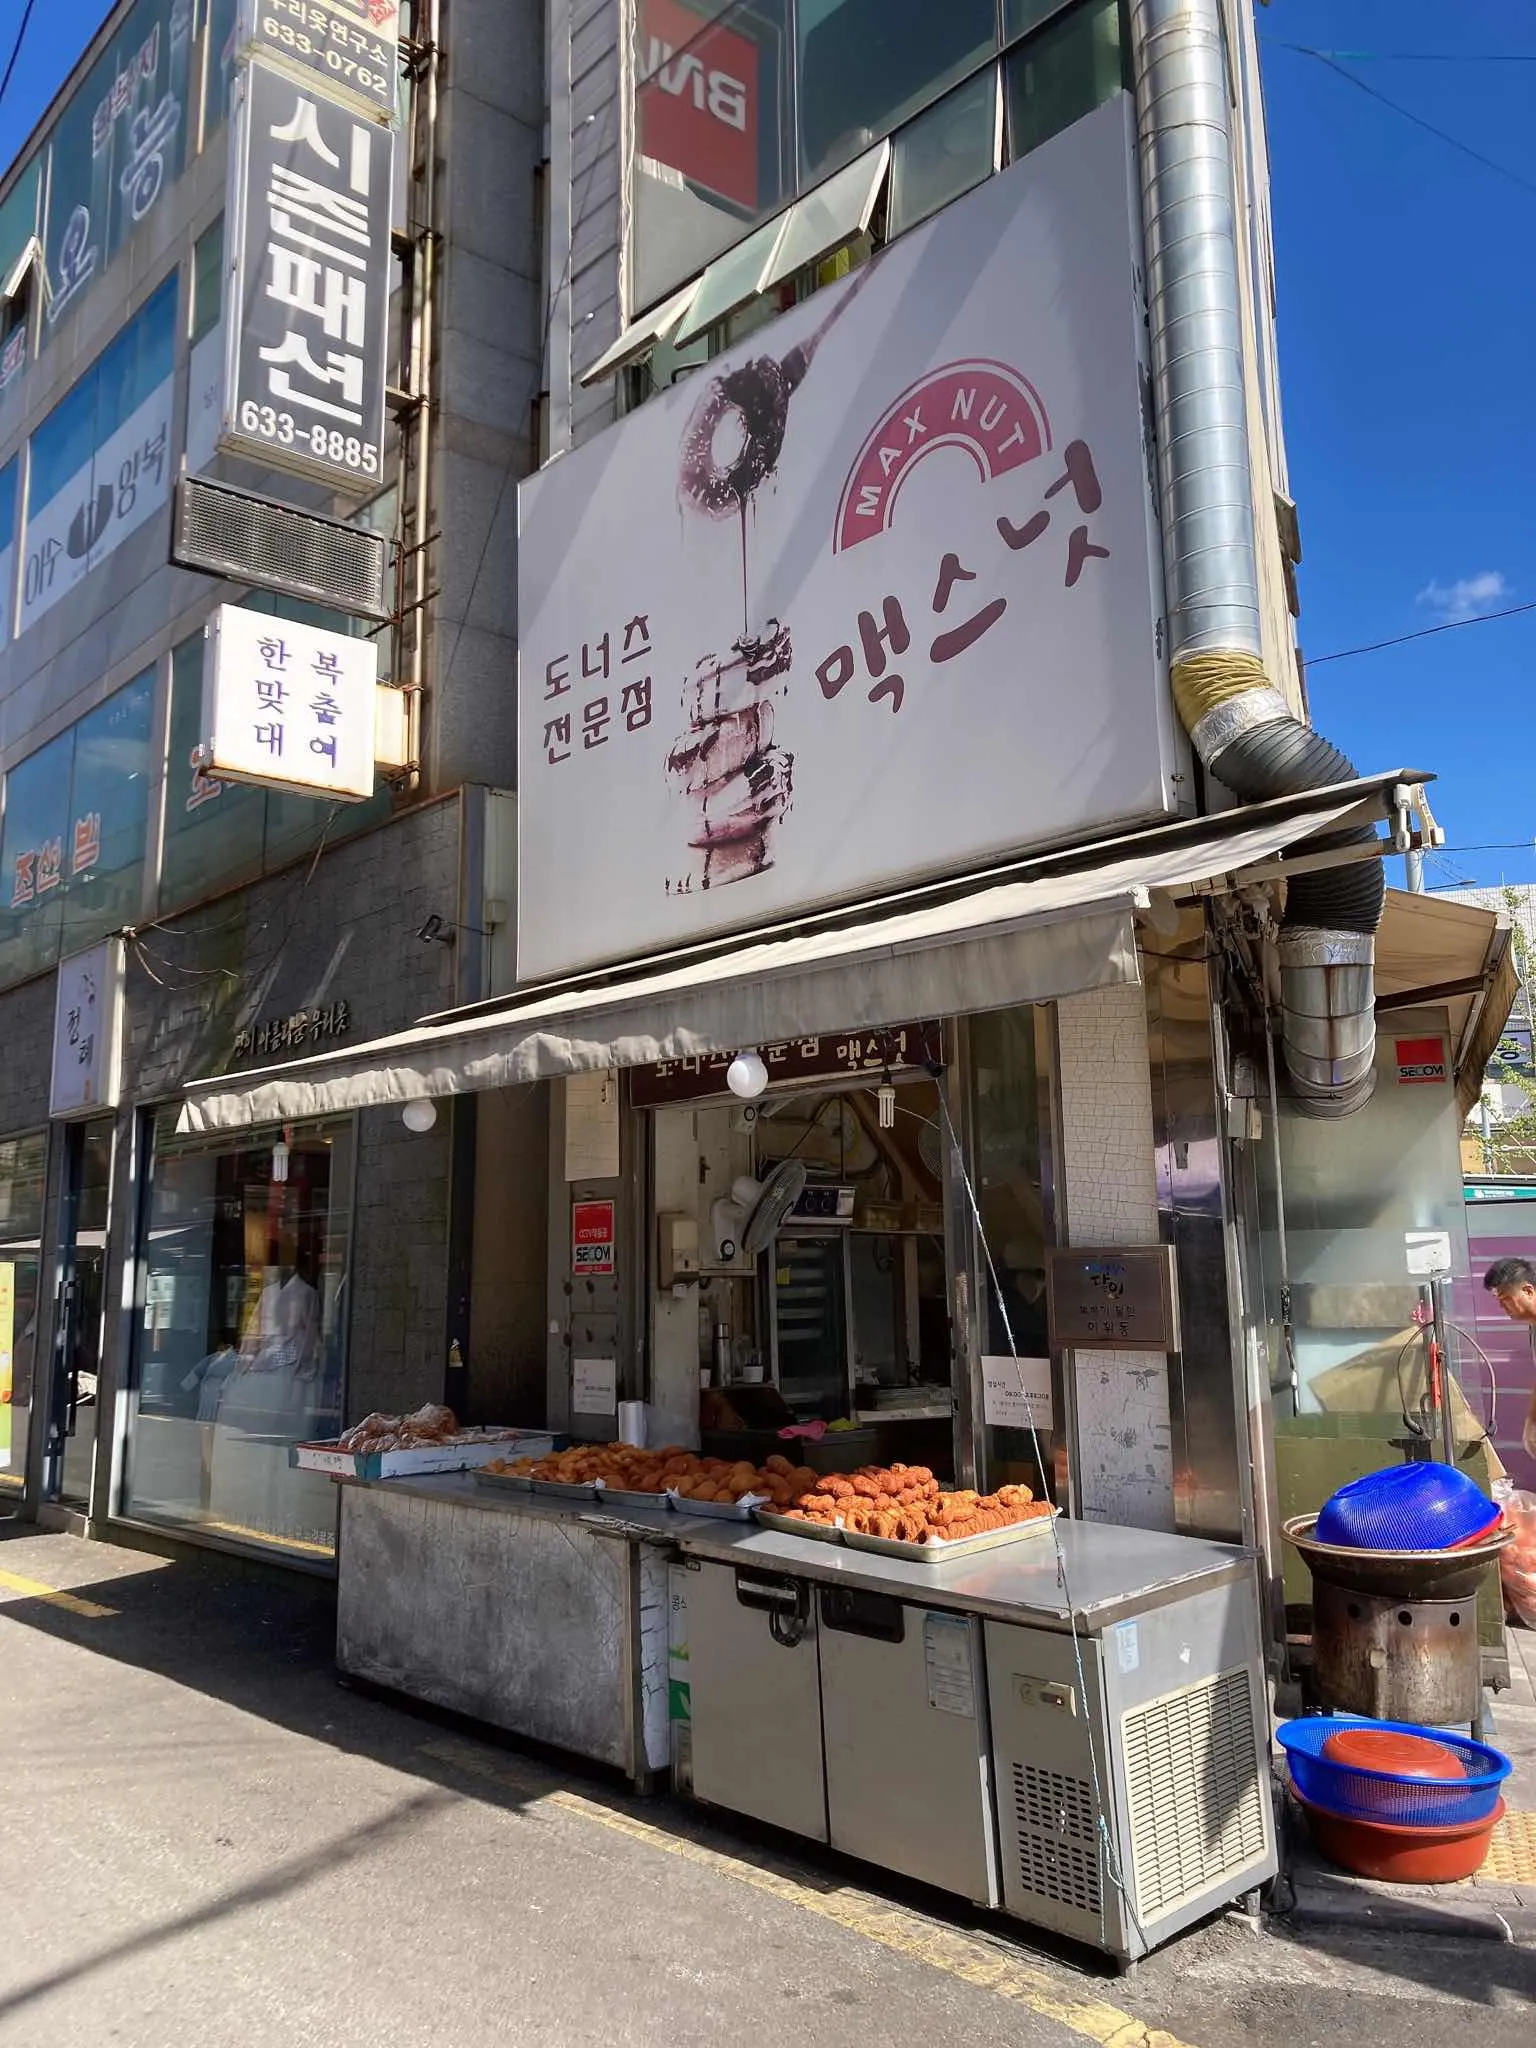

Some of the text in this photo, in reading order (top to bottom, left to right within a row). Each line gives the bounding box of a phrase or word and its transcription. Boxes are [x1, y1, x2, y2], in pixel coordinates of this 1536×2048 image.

[262, 16, 388, 96] 633-0762
[258, 96, 372, 426] 시즌패션
[240, 399, 379, 474] 633-8885
[854, 387, 1026, 517] MAX NUT
[814, 438, 1110, 714] 맥스넛
[256, 635, 345, 687] 한복
[543, 613, 652, 701] 도너츠
[253, 678, 343, 726] 맞춤
[543, 675, 652, 766] 전문점
[253, 721, 338, 769] 대여
[1399, 1064, 1444, 1078] SECOM
[575, 1245, 611, 1263] SECOM
